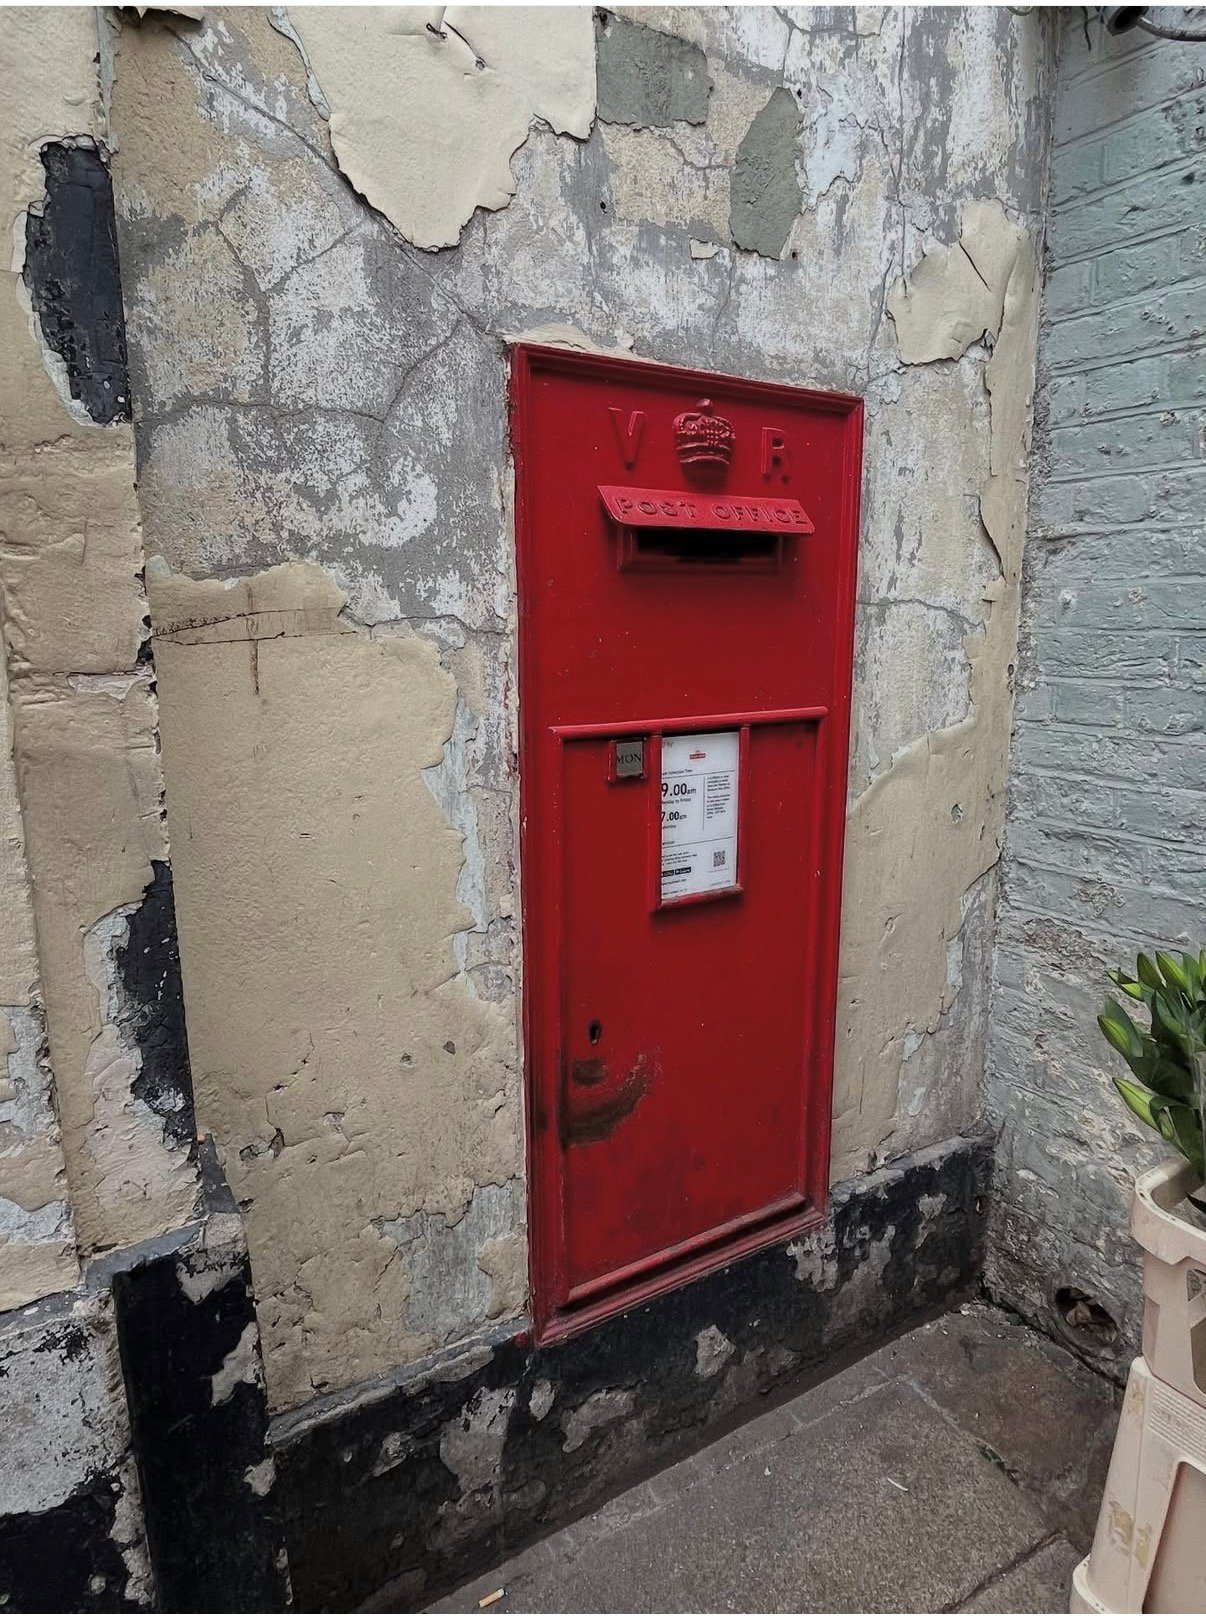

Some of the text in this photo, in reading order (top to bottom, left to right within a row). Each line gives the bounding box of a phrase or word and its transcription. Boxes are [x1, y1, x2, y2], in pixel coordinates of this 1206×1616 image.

[607, 406, 791, 483] V R
[614, 496, 808, 525] POST OFFICE
[616, 753, 642, 766] MON
